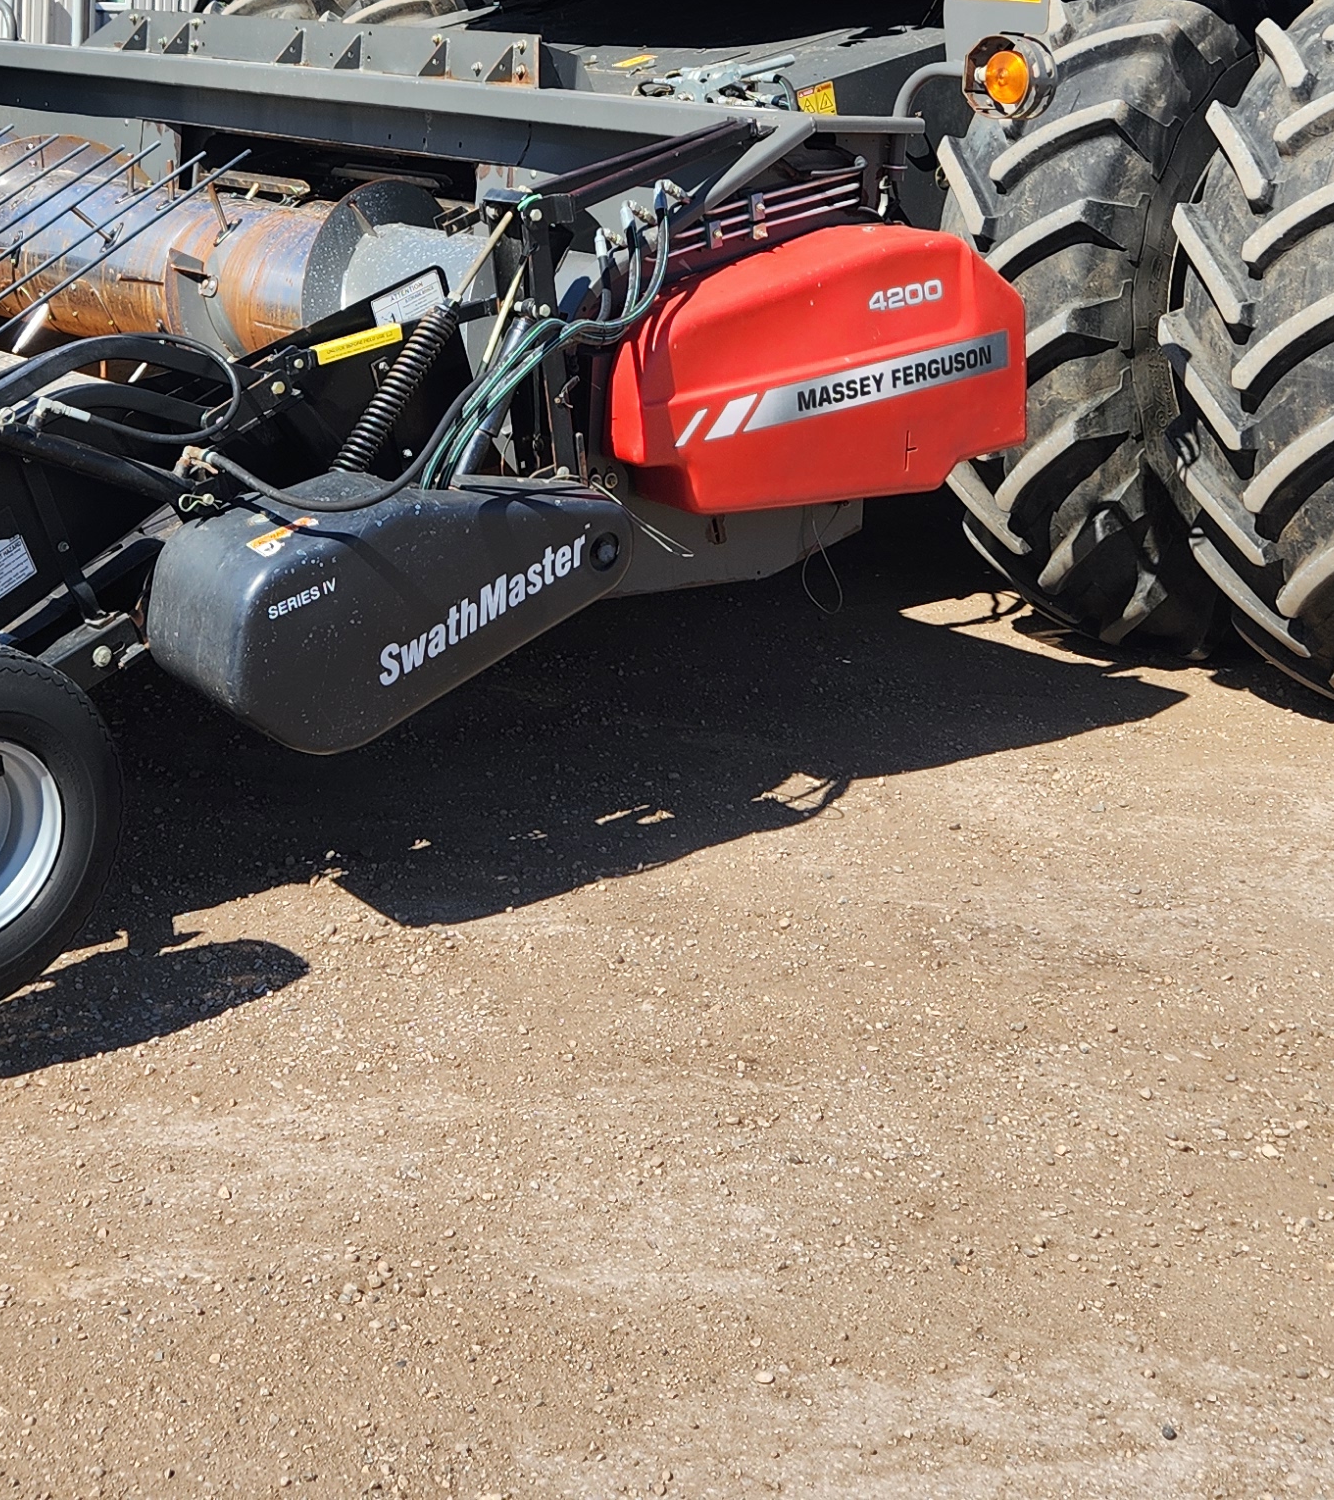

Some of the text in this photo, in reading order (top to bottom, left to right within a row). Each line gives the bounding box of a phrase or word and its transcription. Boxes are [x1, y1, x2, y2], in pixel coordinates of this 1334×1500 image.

[868, 279, 943, 311] 4200
[796, 344, 992, 412] MASSEY FERGUSON
[267, 577, 337, 620] SERIES IV
[378, 533, 587, 687] SwathMaster
